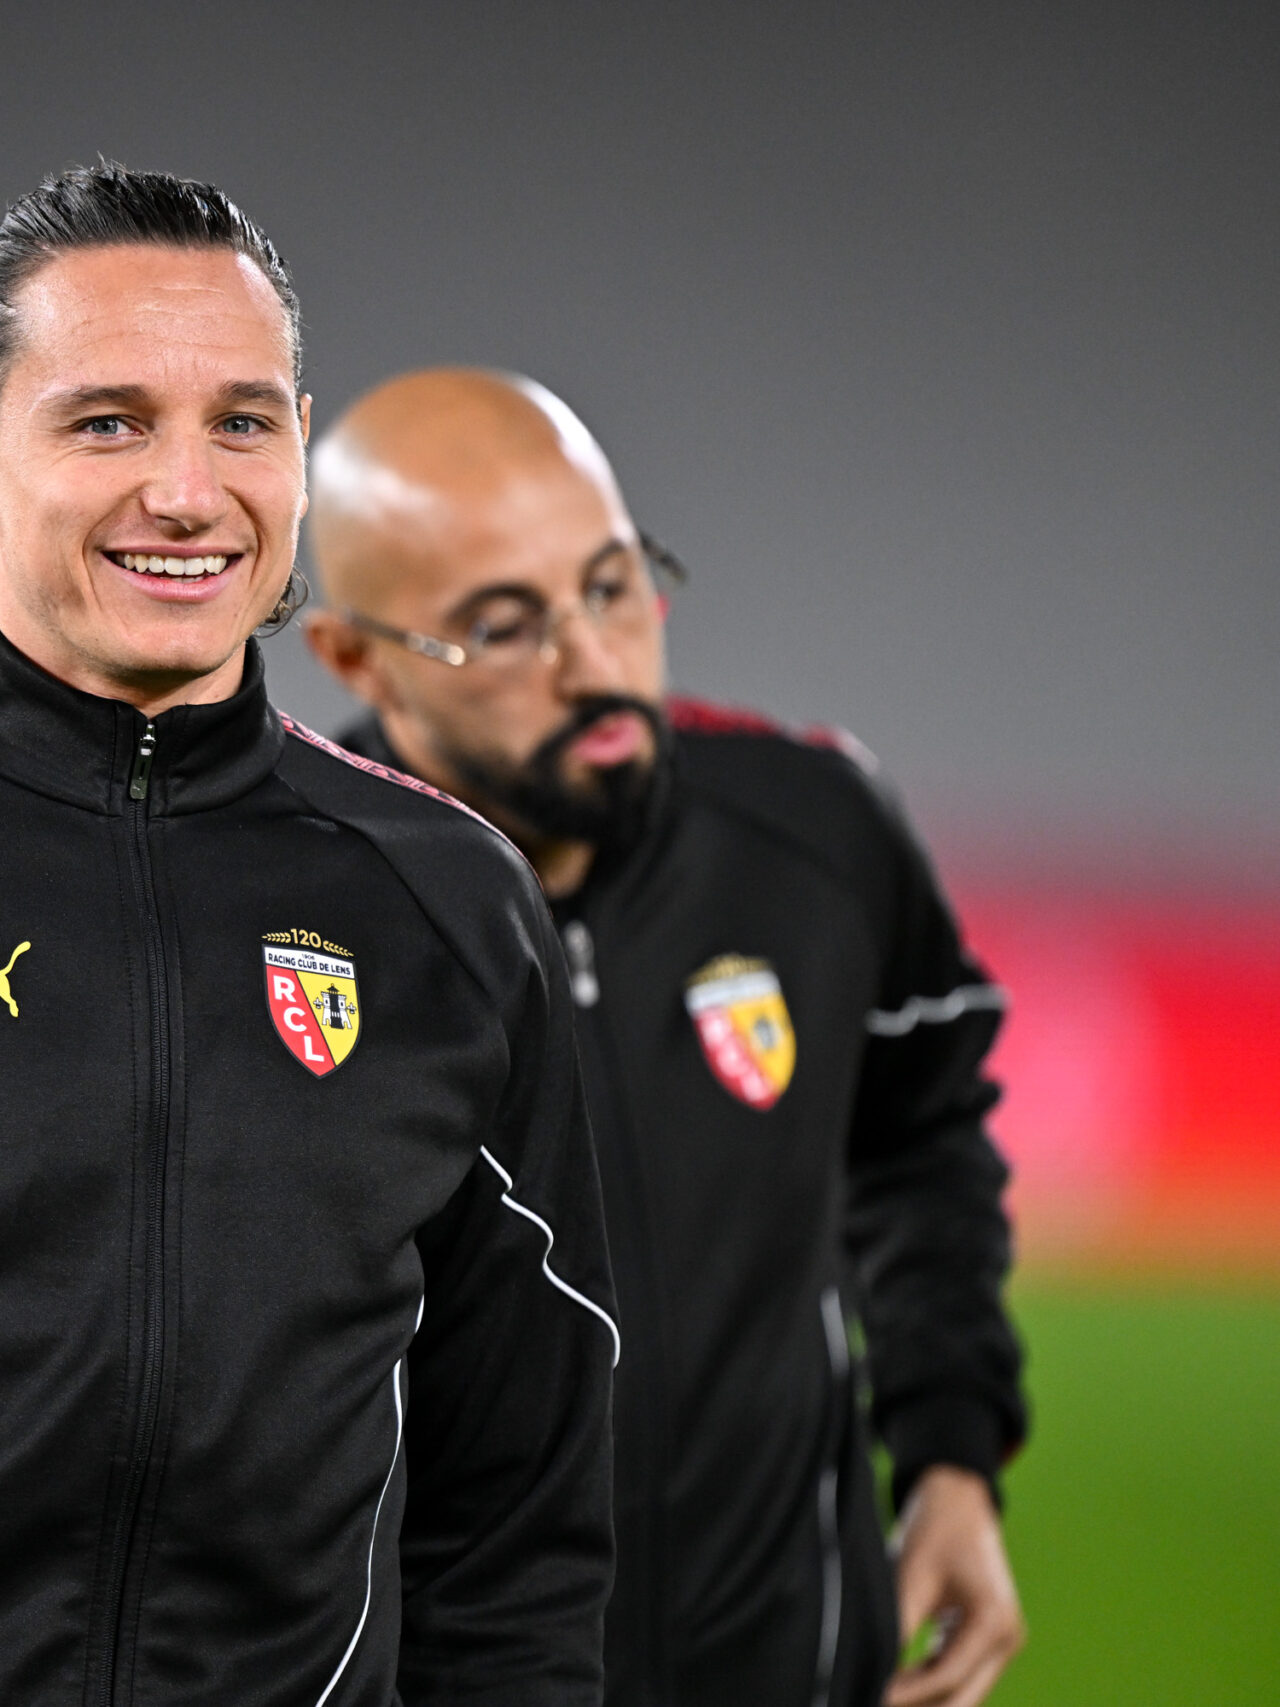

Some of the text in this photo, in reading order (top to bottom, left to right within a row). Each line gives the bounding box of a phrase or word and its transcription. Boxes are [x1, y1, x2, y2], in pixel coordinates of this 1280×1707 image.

[290, 928, 322, 948] 120
[268, 953, 351, 975] RACING CLUB DE LENS
